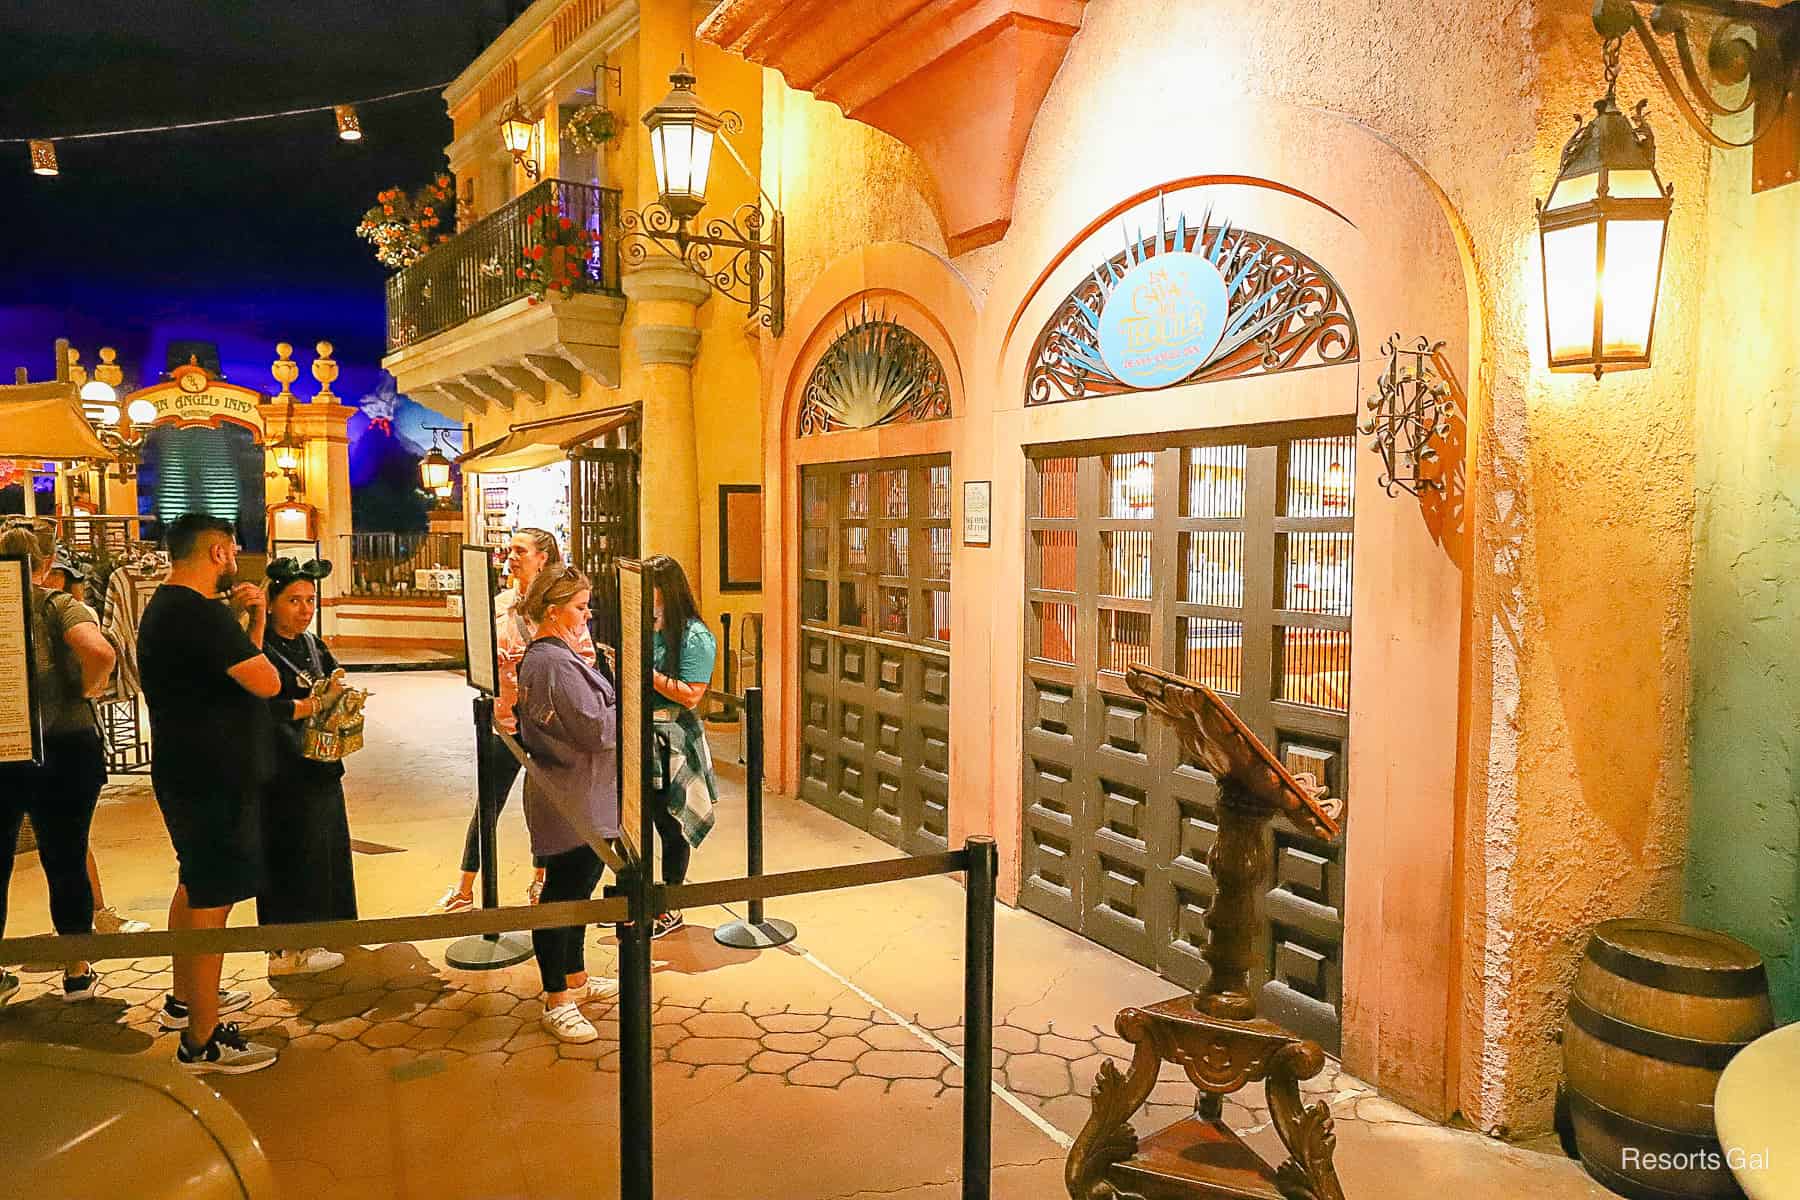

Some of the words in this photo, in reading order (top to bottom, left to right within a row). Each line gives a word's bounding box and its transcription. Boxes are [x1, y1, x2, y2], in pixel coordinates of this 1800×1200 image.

[1118, 301, 1206, 352] TEQUILA
[175, 395, 220, 409] ANGEL
[224, 397, 252, 413] INN
